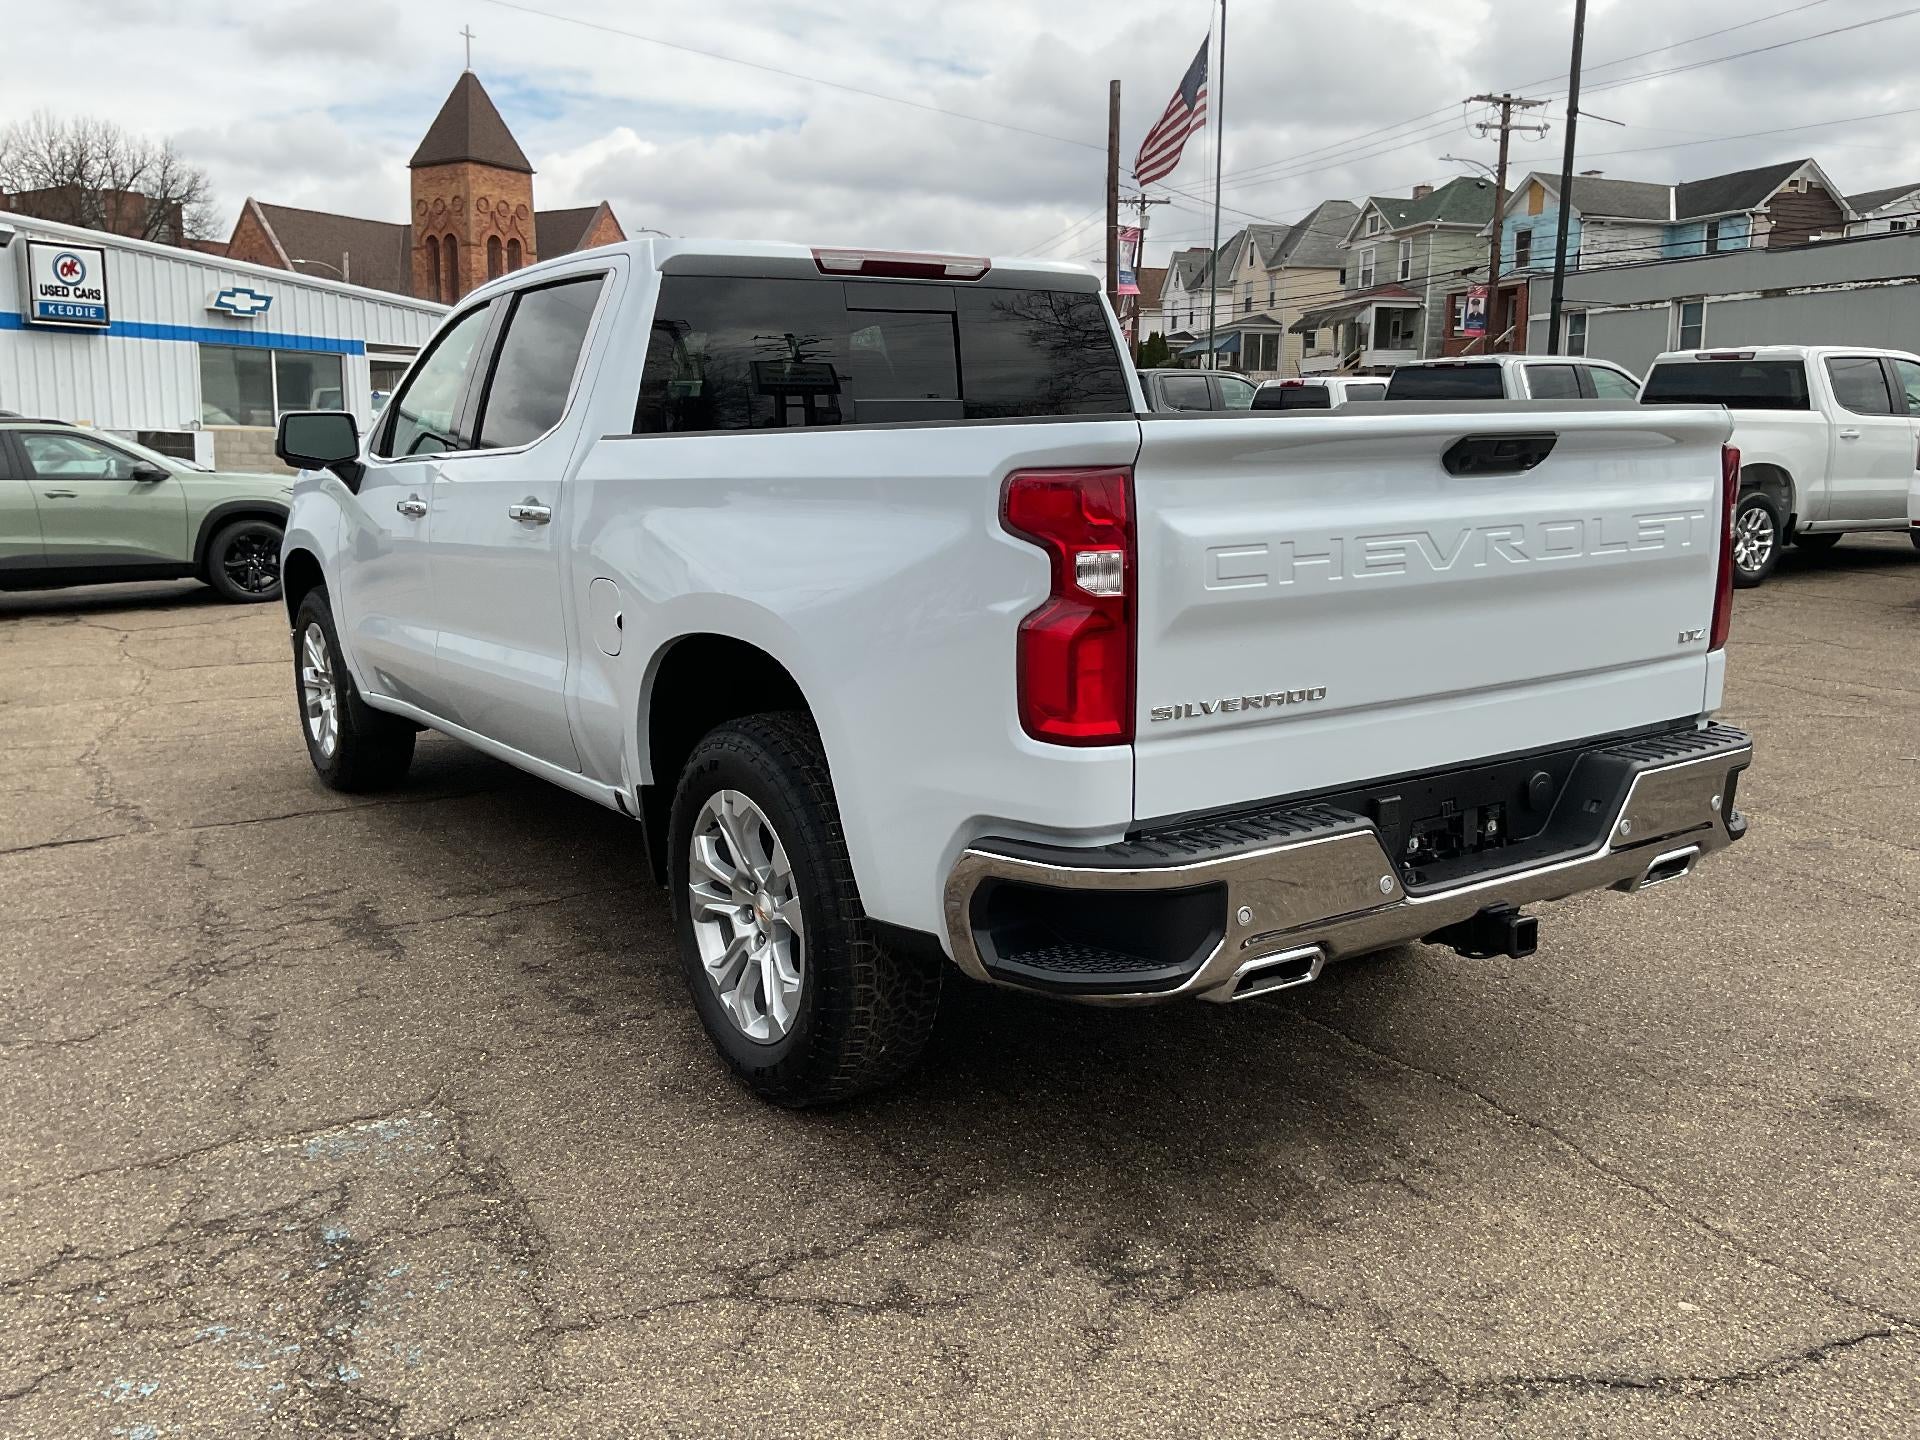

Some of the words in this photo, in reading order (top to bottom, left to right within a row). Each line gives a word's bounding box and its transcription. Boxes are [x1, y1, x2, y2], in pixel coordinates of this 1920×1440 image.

[60, 260, 80, 276] OK
[40, 284, 69, 297] USED
[74, 287, 101, 300] CARS
[48, 305, 97, 317] KEDDIE
[1204, 509, 1705, 591] CHEVROLET
[1150, 685, 1327, 722] SILVERADO
